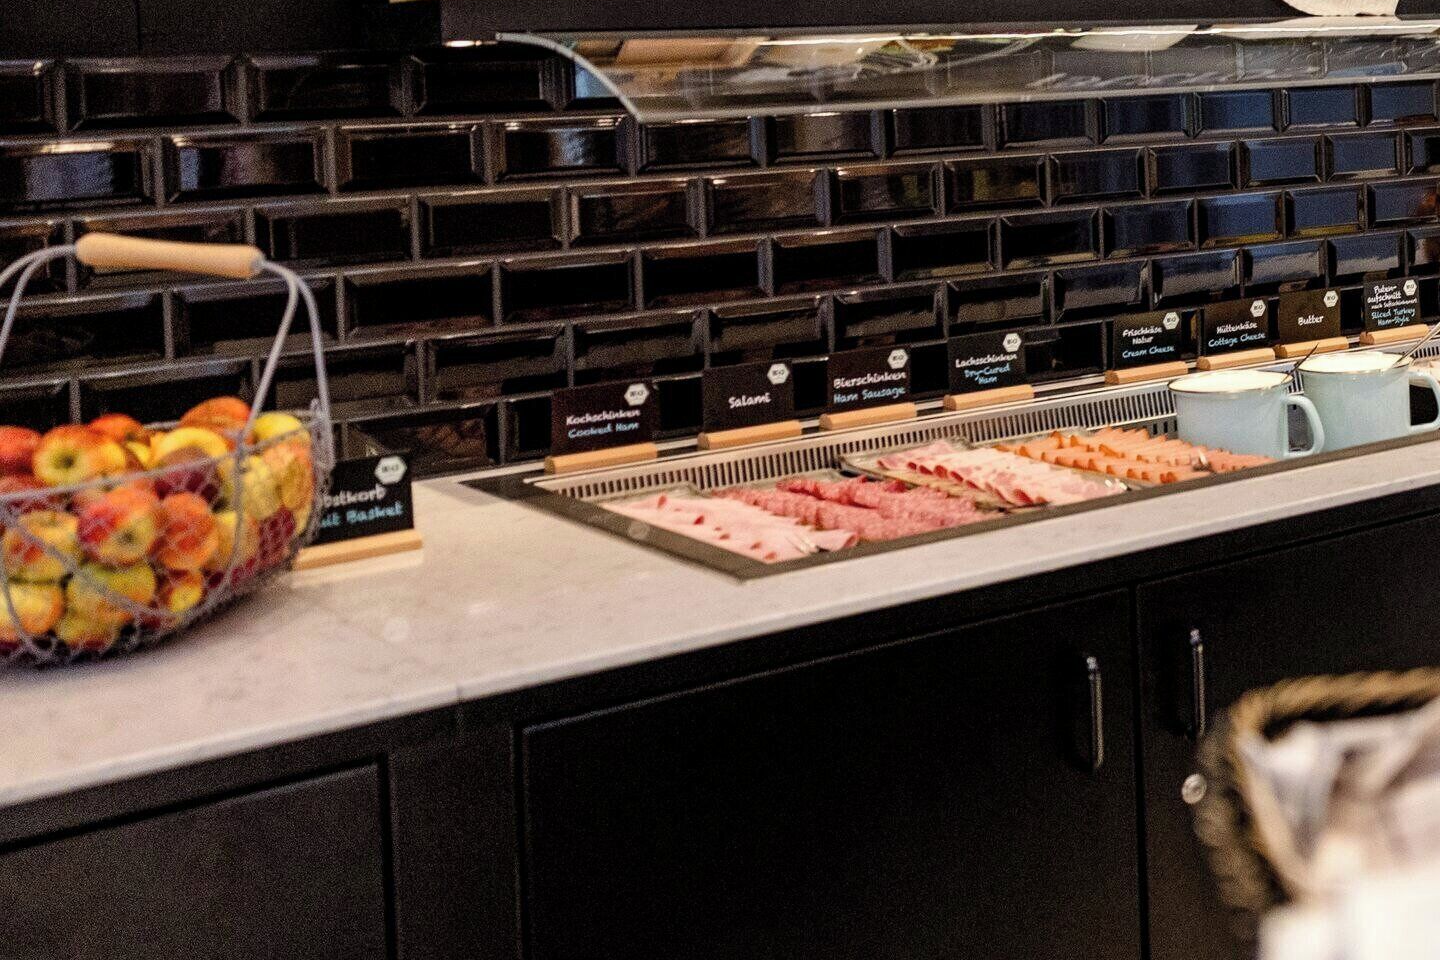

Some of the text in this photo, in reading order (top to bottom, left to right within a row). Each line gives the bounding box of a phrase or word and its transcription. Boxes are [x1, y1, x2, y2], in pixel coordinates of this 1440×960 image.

[1216, 321, 1258, 334] Hüttenkäse
[1298, 315, 1324, 326] Butter
[1122, 325, 1163, 337] Frischkäse
[1208, 331, 1266, 348] Cottage Cheese
[1122, 345, 1175, 359] Cream Cheese
[833, 371, 907, 388] Bierschinken
[978, 375, 998, 385] Ham
[728, 392, 772, 408] Salami
[833, 386, 906, 403] Ham Sausage
[566, 408, 642, 425] Kochschinken
[567, 421, 640, 438] Cooked Ham
